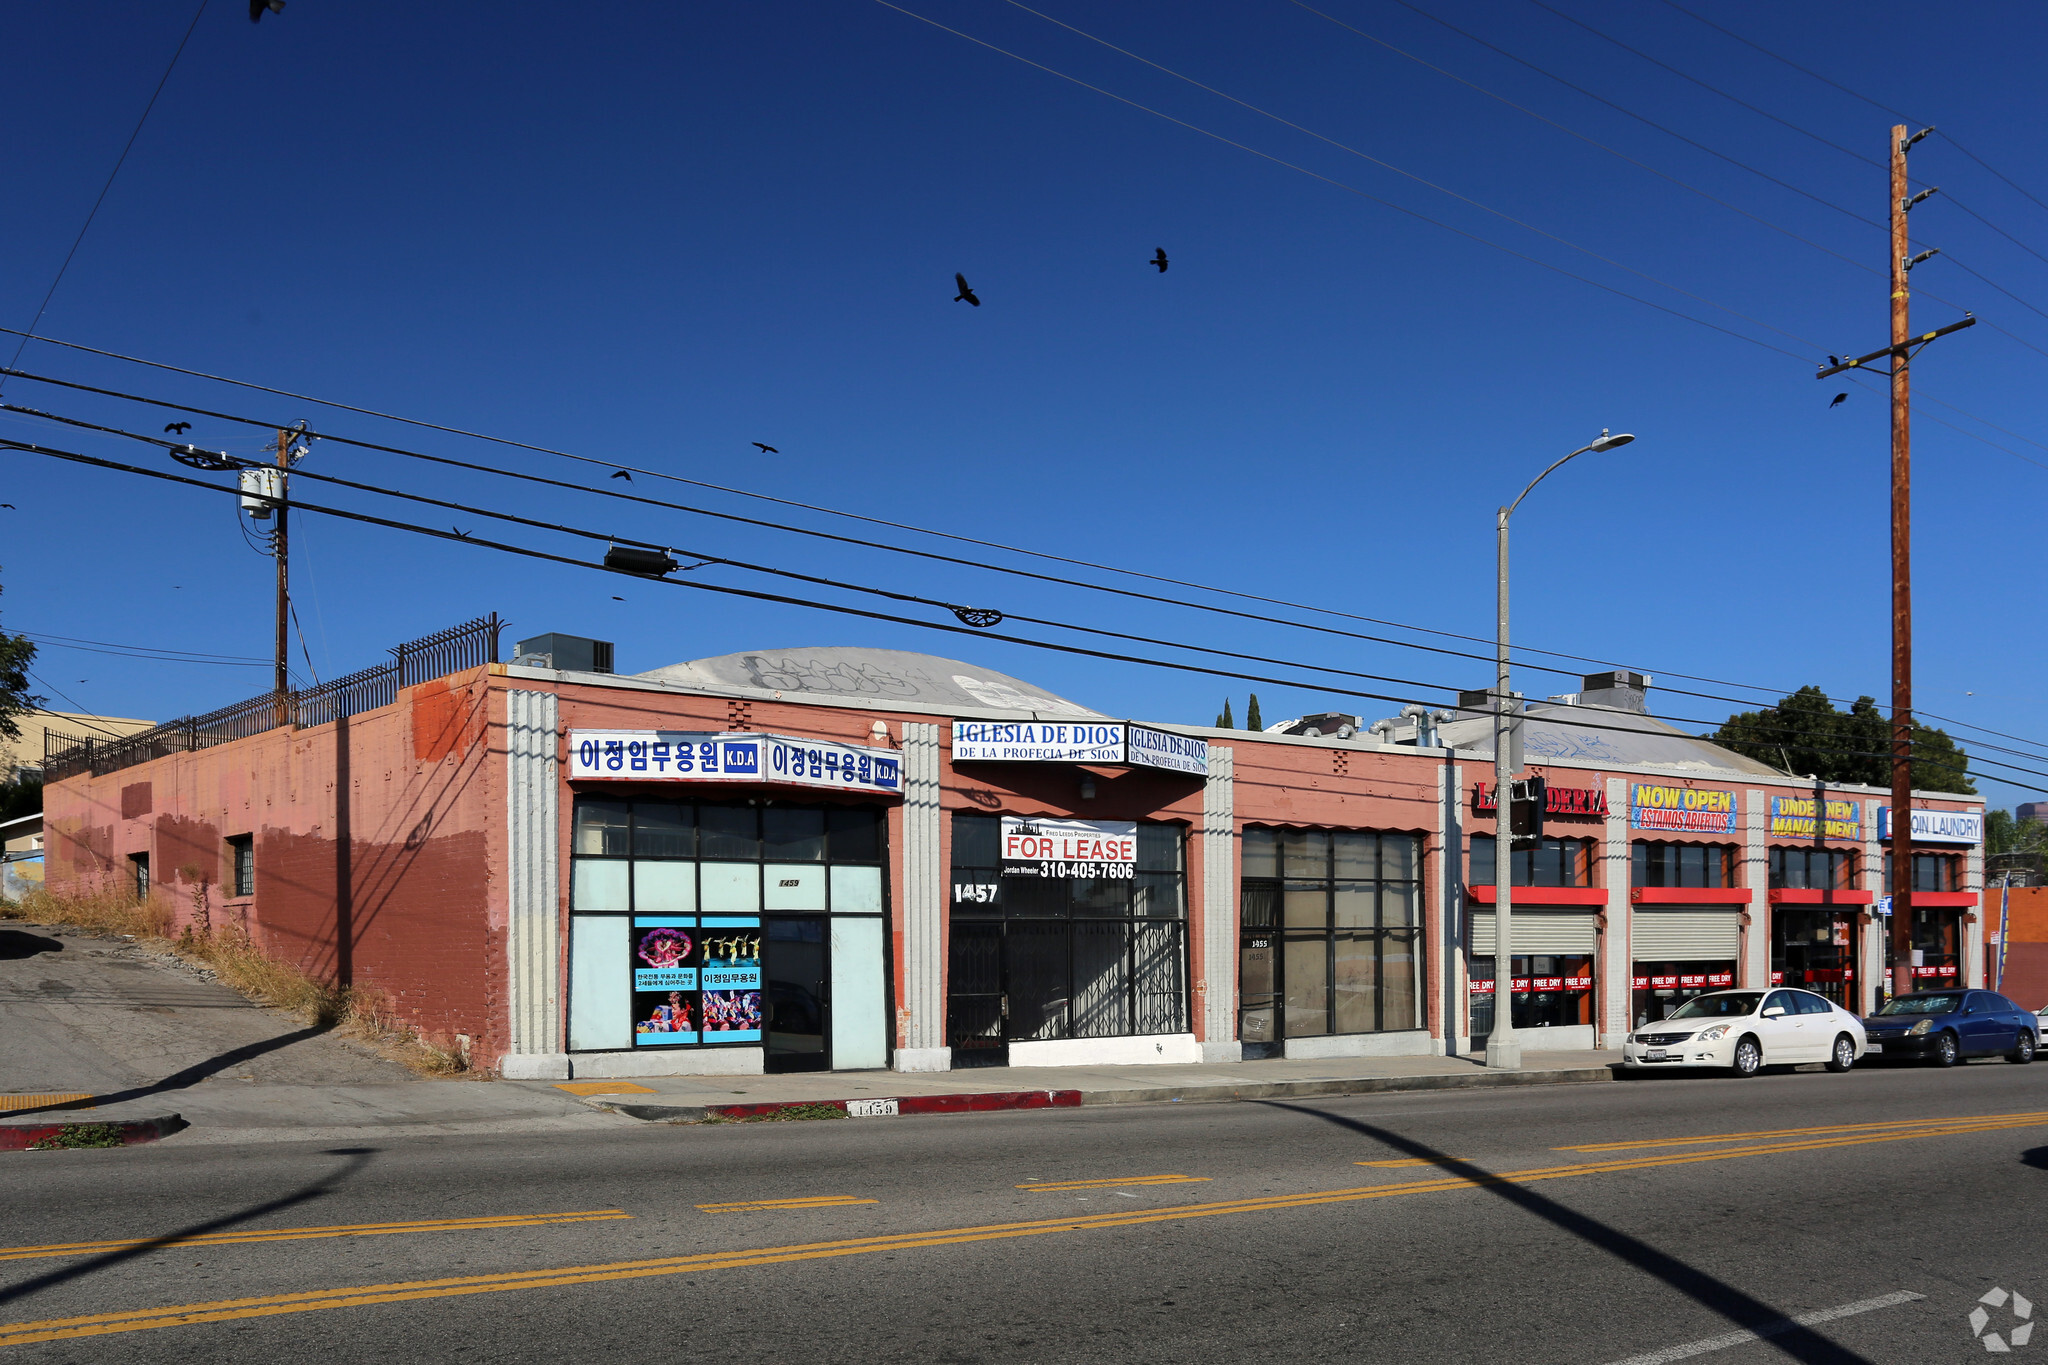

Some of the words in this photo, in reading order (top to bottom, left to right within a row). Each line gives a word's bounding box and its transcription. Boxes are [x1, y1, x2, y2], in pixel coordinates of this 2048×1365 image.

[959, 724, 1036, 743] IGLESIA
[1041, 725, 1067, 743] DE
[1073, 726, 1119, 745] DIOS
[1130, 728, 1168, 752] IGLESIA
[1170, 737, 1182, 755] DE
[1185, 740, 1206, 759] DIOS
[580, 740, 718, 772] 이정임무용원
[726, 750, 755, 766] K.D.A
[960, 747, 976, 757] DE
[982, 748, 997, 758] LA
[1003, 748, 1062, 759] PROFECIA
[1069, 750, 1084, 759] DE
[1091, 750, 1119, 759] SION
[773, 745, 871, 784] 이정임무용원
[1131, 751, 1139, 762] DE
[1142, 753, 1150, 763] LA
[1152, 755, 1180, 769] PROFECIA
[1183, 760, 1190, 770] DE
[1193, 762, 1206, 773] SION
[876, 764, 896, 780] K.D.A
[1637, 785, 1680, 809] NOW
[1684, 789, 1731, 812] OPEN
[1779, 799, 1823, 817] UNDER
[1825, 801, 1853, 820] NEW
[1640, 808, 1685, 829] ESTAMOS
[1685, 811, 1728, 831] ABIERTOS
[1911, 815, 1928, 834] OIN
[1933, 816, 1979, 837] LAUNDRY
[1074, 831, 1101, 839] PROPERTIES
[1772, 818, 1858, 840] MANAGEMENT
[1007, 837, 1053, 858] FOR
[1064, 839, 1132, 860] LEASE
[1004, 866, 1020, 874] Jordan
[1020, 866, 1039, 874] Wheeler
[1041, 861, 1134, 879] 310-405-7606
[779, 879, 800, 887] 1459
[955, 884, 997, 903] 1457
[704, 973, 757, 984] 이정임무용원
[1482, 981, 1494, 989] DRY
[1516, 979, 1529, 987] DRY
[1533, 979, 1547, 987] FREE
[1549, 978, 1561, 987] DRY
[1565, 977, 1578, 986] FREE
[1580, 977, 1592, 985] DRY
[1652, 977, 1664, 985] FREE
[1666, 976, 1676, 984] DRY
[1681, 976, 1693, 984] FREE
[1694, 975, 1705, 983] DRY
[1721, 974, 1731, 982] DRY
[860, 1105, 892, 1115] 1459
